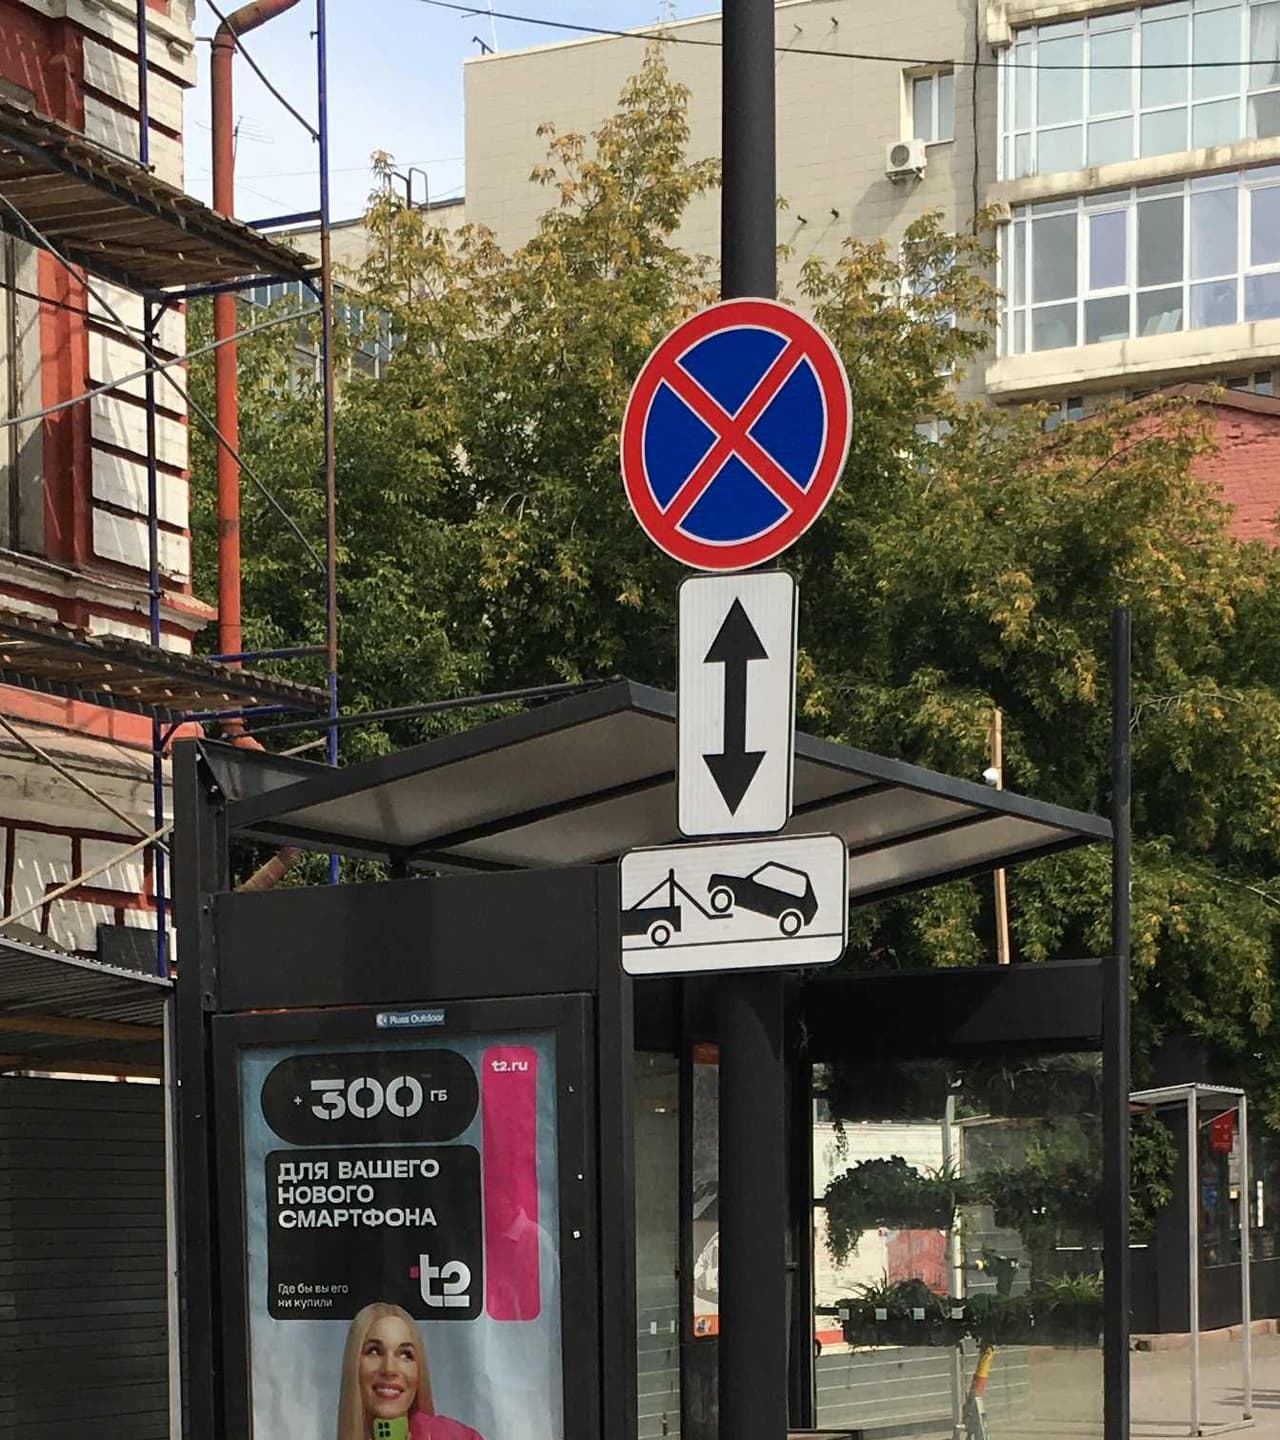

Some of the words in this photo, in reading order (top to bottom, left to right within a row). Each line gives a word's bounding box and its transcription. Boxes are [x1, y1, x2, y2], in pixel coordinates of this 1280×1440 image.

[411, 1014, 444, 1023] Outdoor
[491, 1060, 528, 1071] t2.ru
[310, 1075, 423, 1120] 300
[430, 1090, 448, 1101] ГБ
[278, 1163, 328, 1184] ДЛЯ
[338, 1159, 440, 1179] ВАШЕГО
[278, 1185, 374, 1204] НОВОГО
[278, 1208, 437, 1228] СМАРТФОНА
[278, 1283, 296, 1295] Где
[297, 1283, 313, 1293] бы
[315, 1285, 329, 1293] вы
[331, 1285, 349, 1293] его
[419, 1253, 471, 1307] t2
[278, 1299, 292, 1307] ни
[294, 1299, 333, 1309] купили
